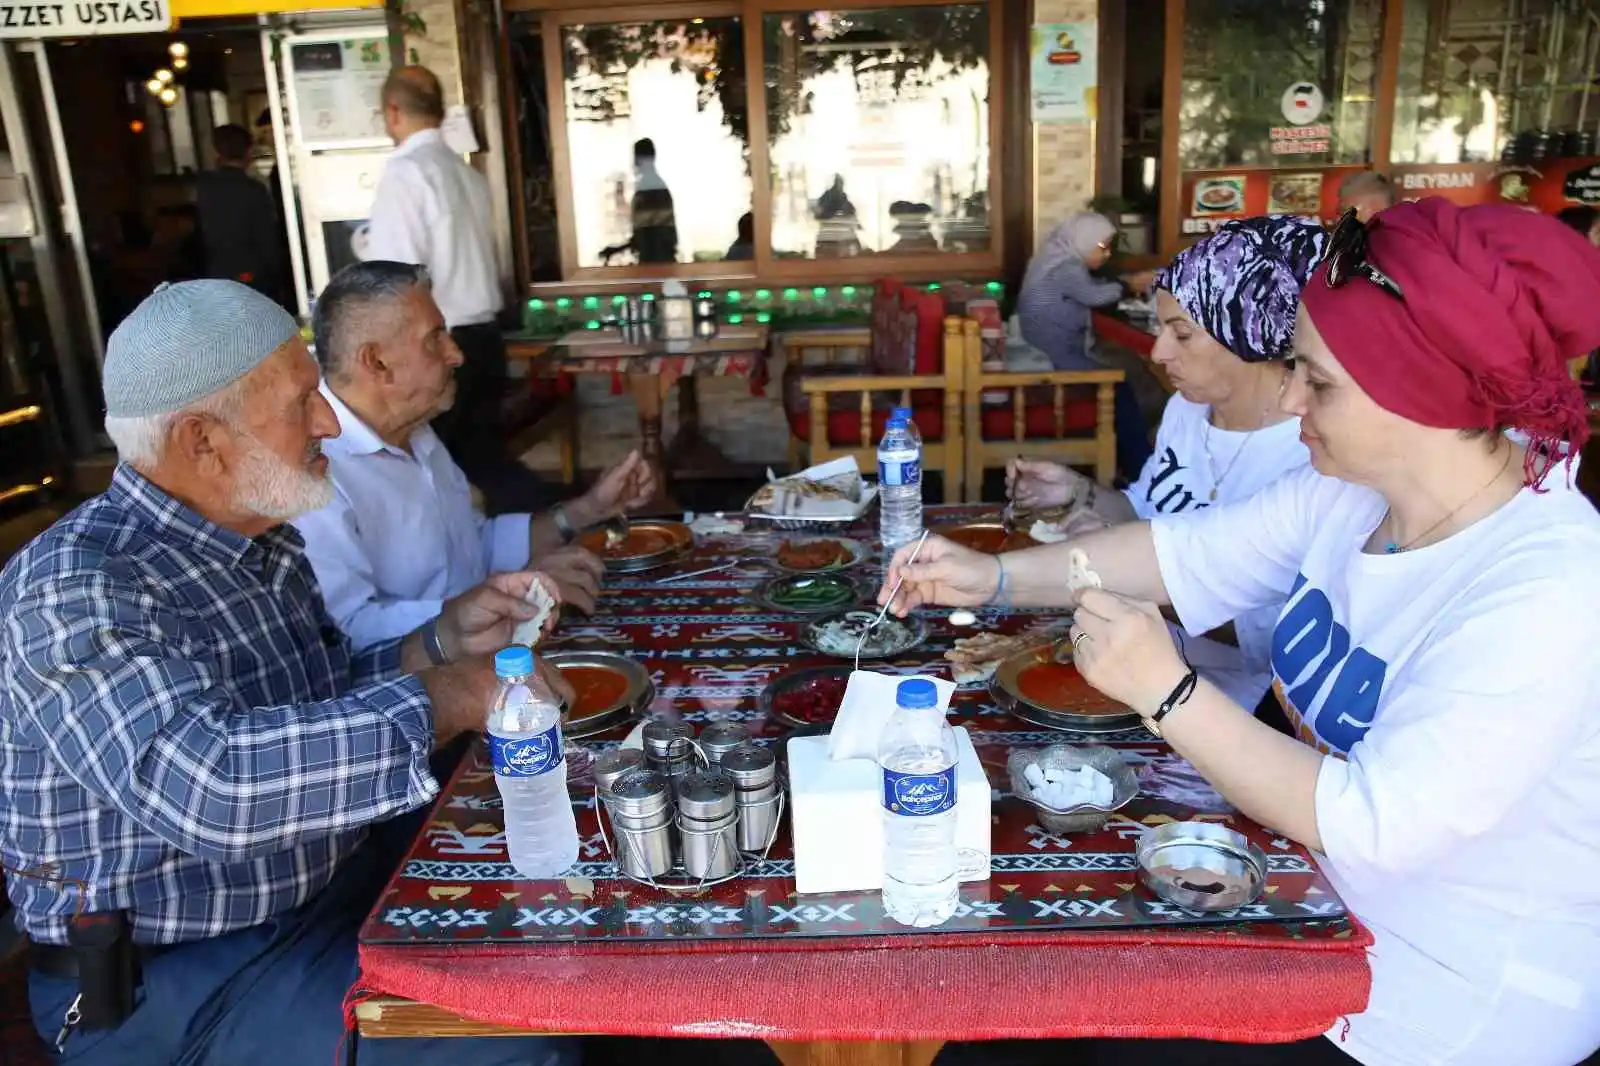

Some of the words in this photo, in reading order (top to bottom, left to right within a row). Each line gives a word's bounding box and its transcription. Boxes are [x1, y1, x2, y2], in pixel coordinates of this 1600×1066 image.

[1, 5, 64, 27] ZZET
[75, 0, 164, 24] USTASI
[1403, 172, 1475, 189] BEYRAN
